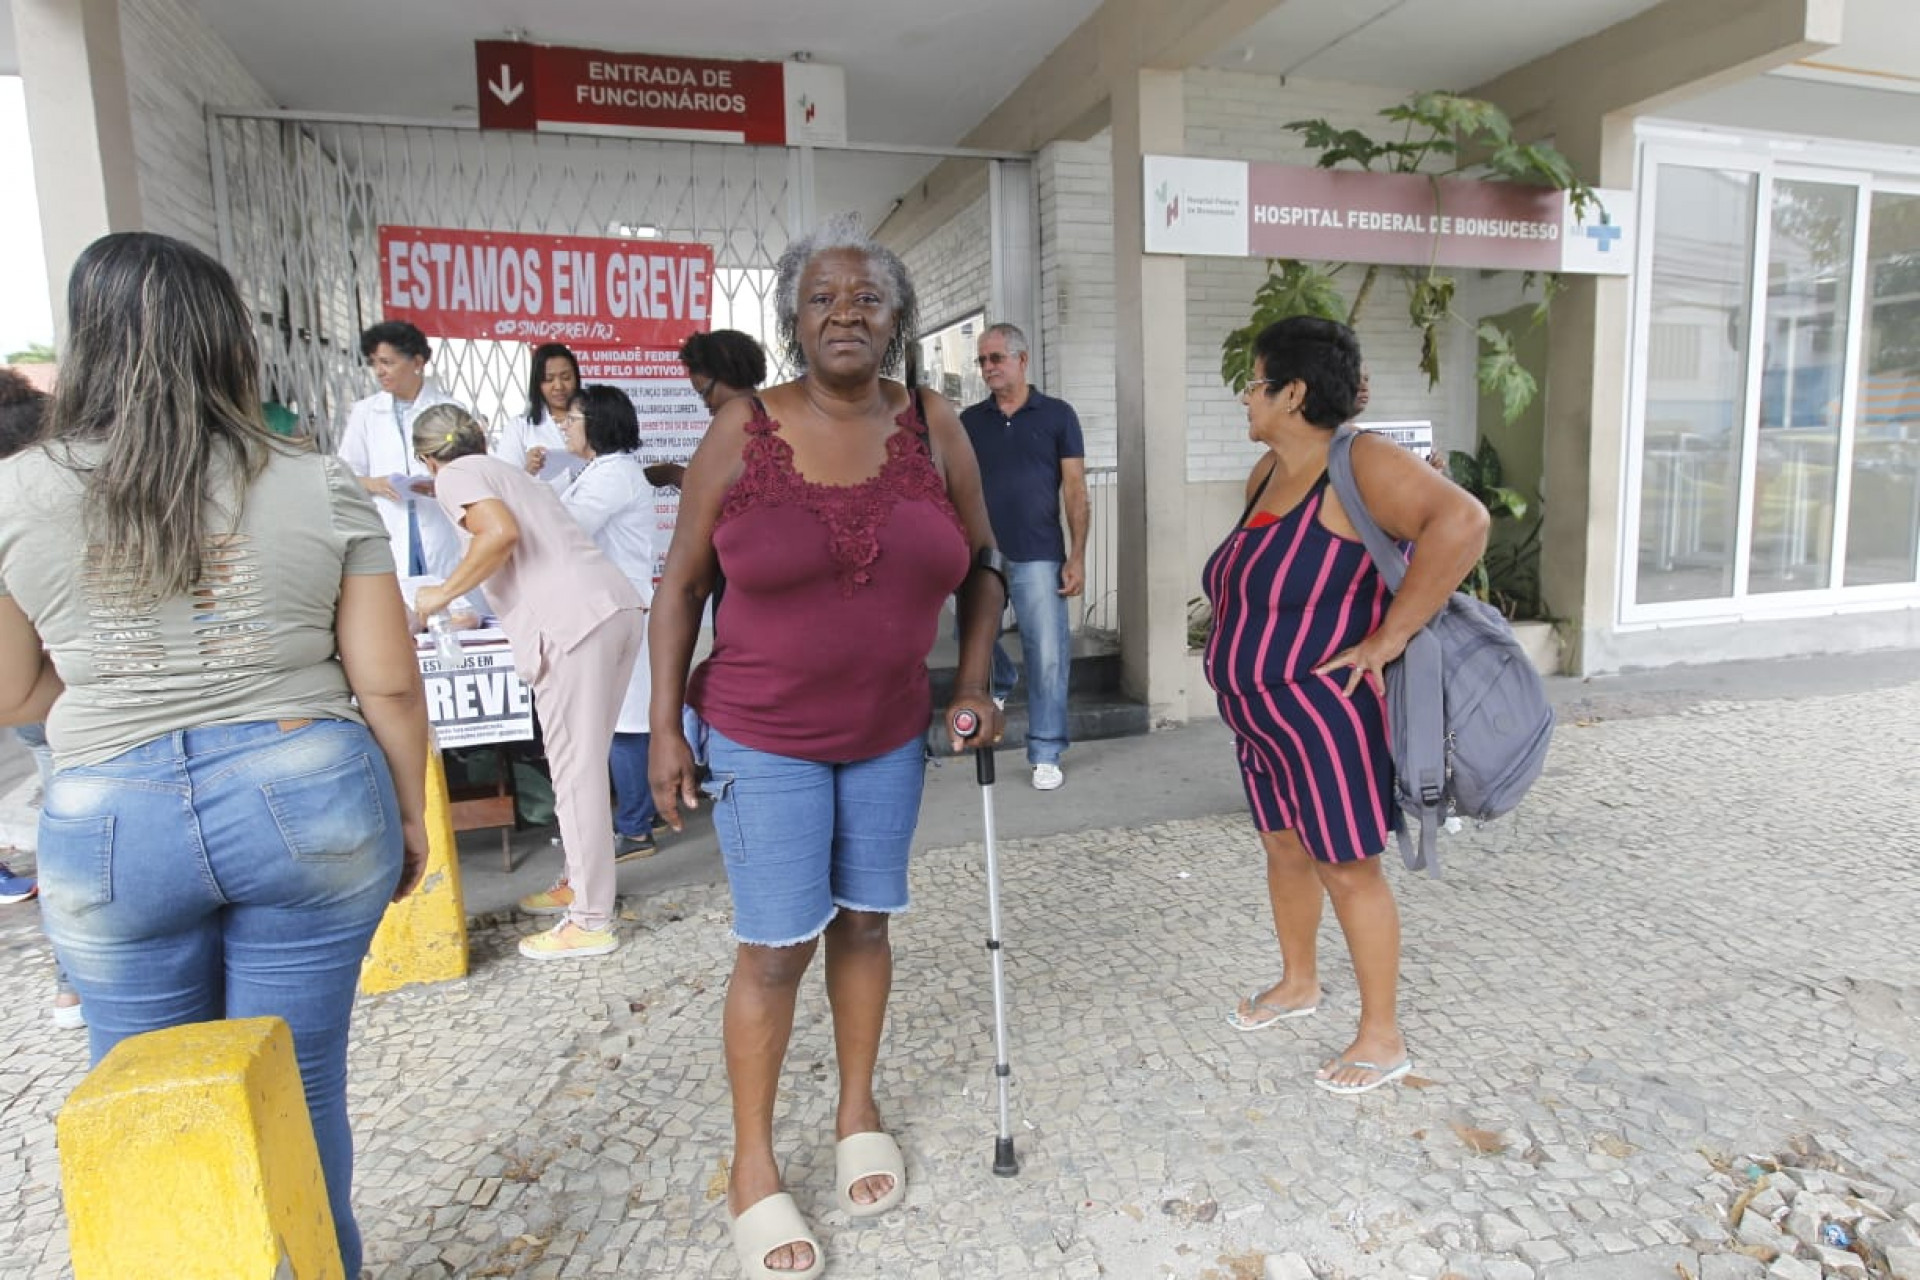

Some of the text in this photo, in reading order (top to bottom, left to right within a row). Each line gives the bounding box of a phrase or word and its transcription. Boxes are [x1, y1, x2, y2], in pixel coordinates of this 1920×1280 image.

[589, 60, 733, 89] ENTRADA DE
[576, 84, 746, 113] FUNCIONÁRIOS
[1254, 203, 1343, 228] HOSPITAL
[1347, 211, 1425, 233] FEDERAL
[1429, 216, 1451, 235] DE
[1455, 217, 1559, 240] BONSUCESSO
[388, 240, 708, 321] ESTAMOS EM GREVE
[592, 350, 642, 362] UNIDADE
[644, 350, 681, 362] FEDER
[579, 365, 685, 377] EVE PELO MOTIVOS
[424, 671, 530, 721] REVE
